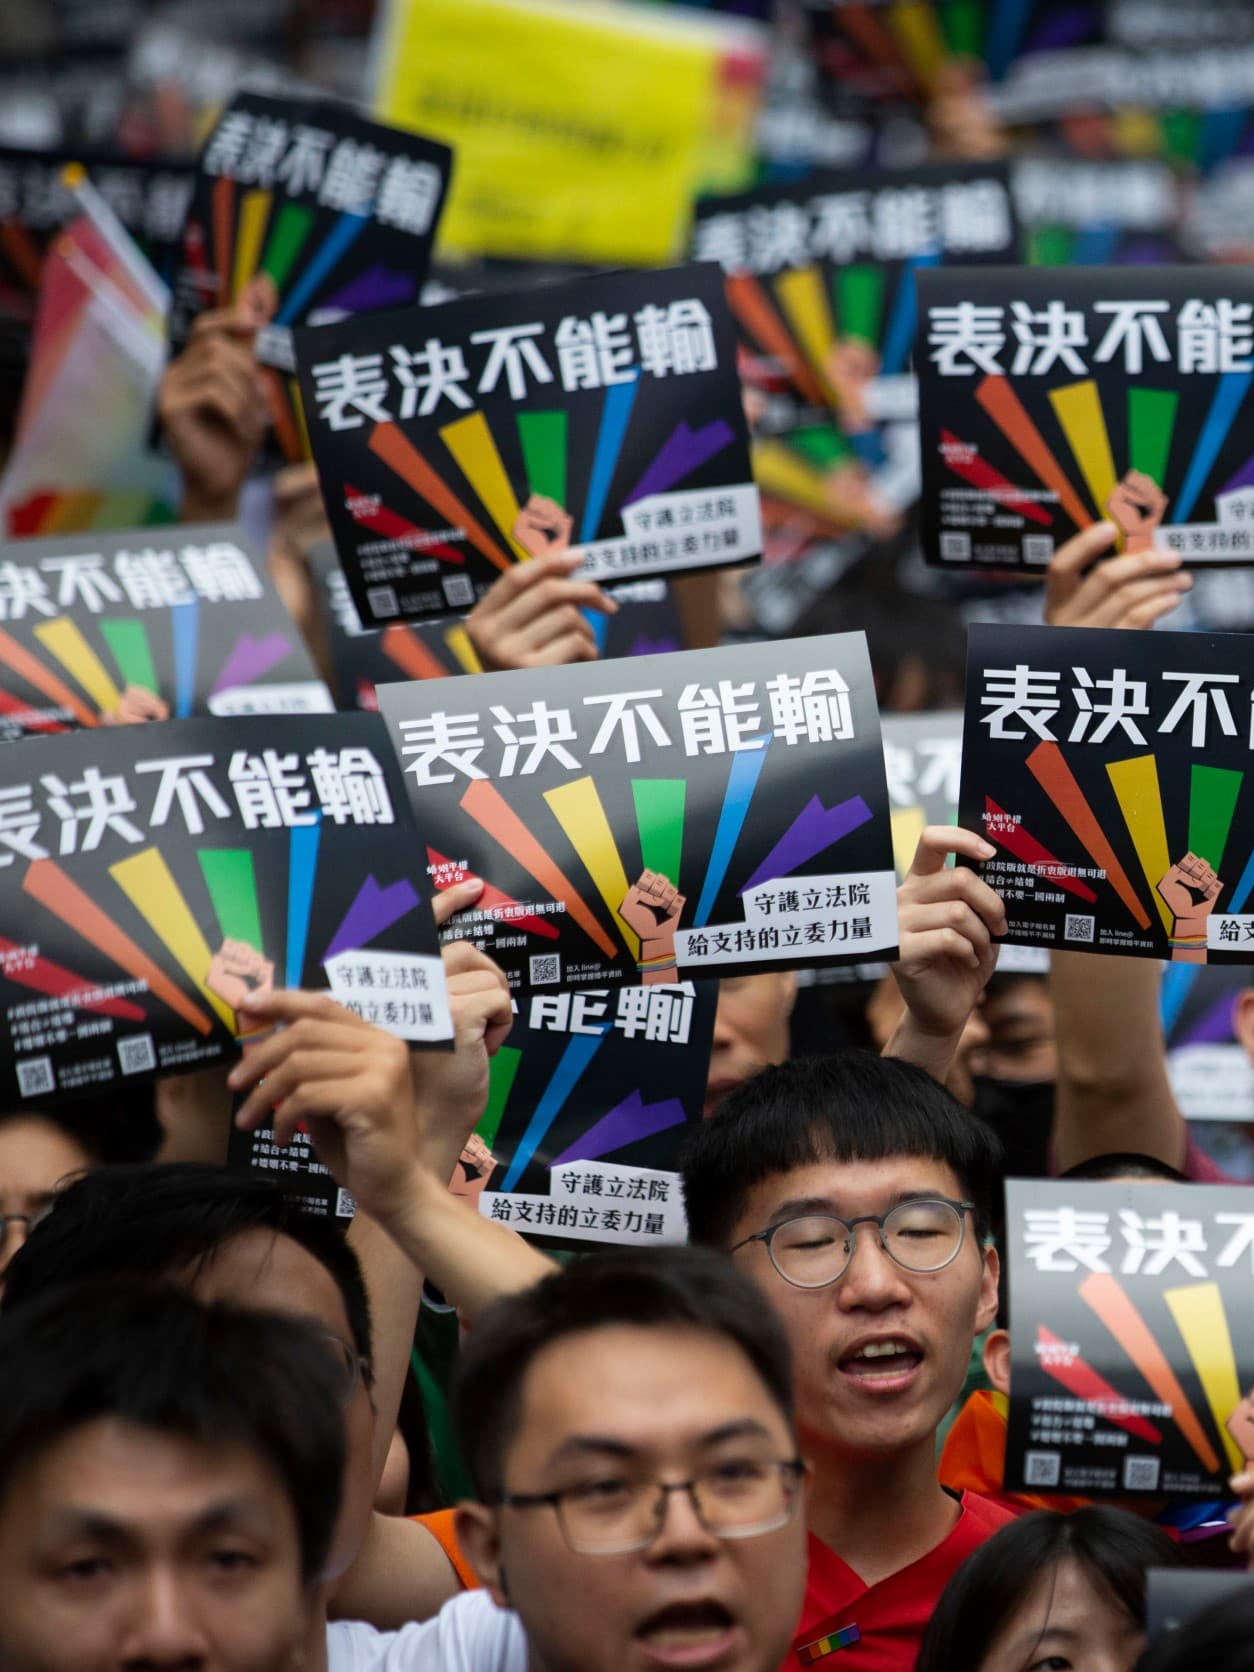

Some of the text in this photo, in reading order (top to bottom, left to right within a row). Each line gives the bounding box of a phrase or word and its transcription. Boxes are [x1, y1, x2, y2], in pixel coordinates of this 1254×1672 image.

[203, 107, 442, 237] 表決不能輸
[311, 298, 718, 431] 表決不能輸
[398, 669, 856, 787] 表決不能輸
[0, 746, 396, 866] 表決不能輸
[754, 884, 871, 914] 守護立法院
[687, 915, 873, 956] 給支持的立委力量
[511, 982, 697, 1044] 能輸
[491, 1196, 666, 1236] 給支持的立委力量
[560, 1169, 670, 1203] 守護立法院
